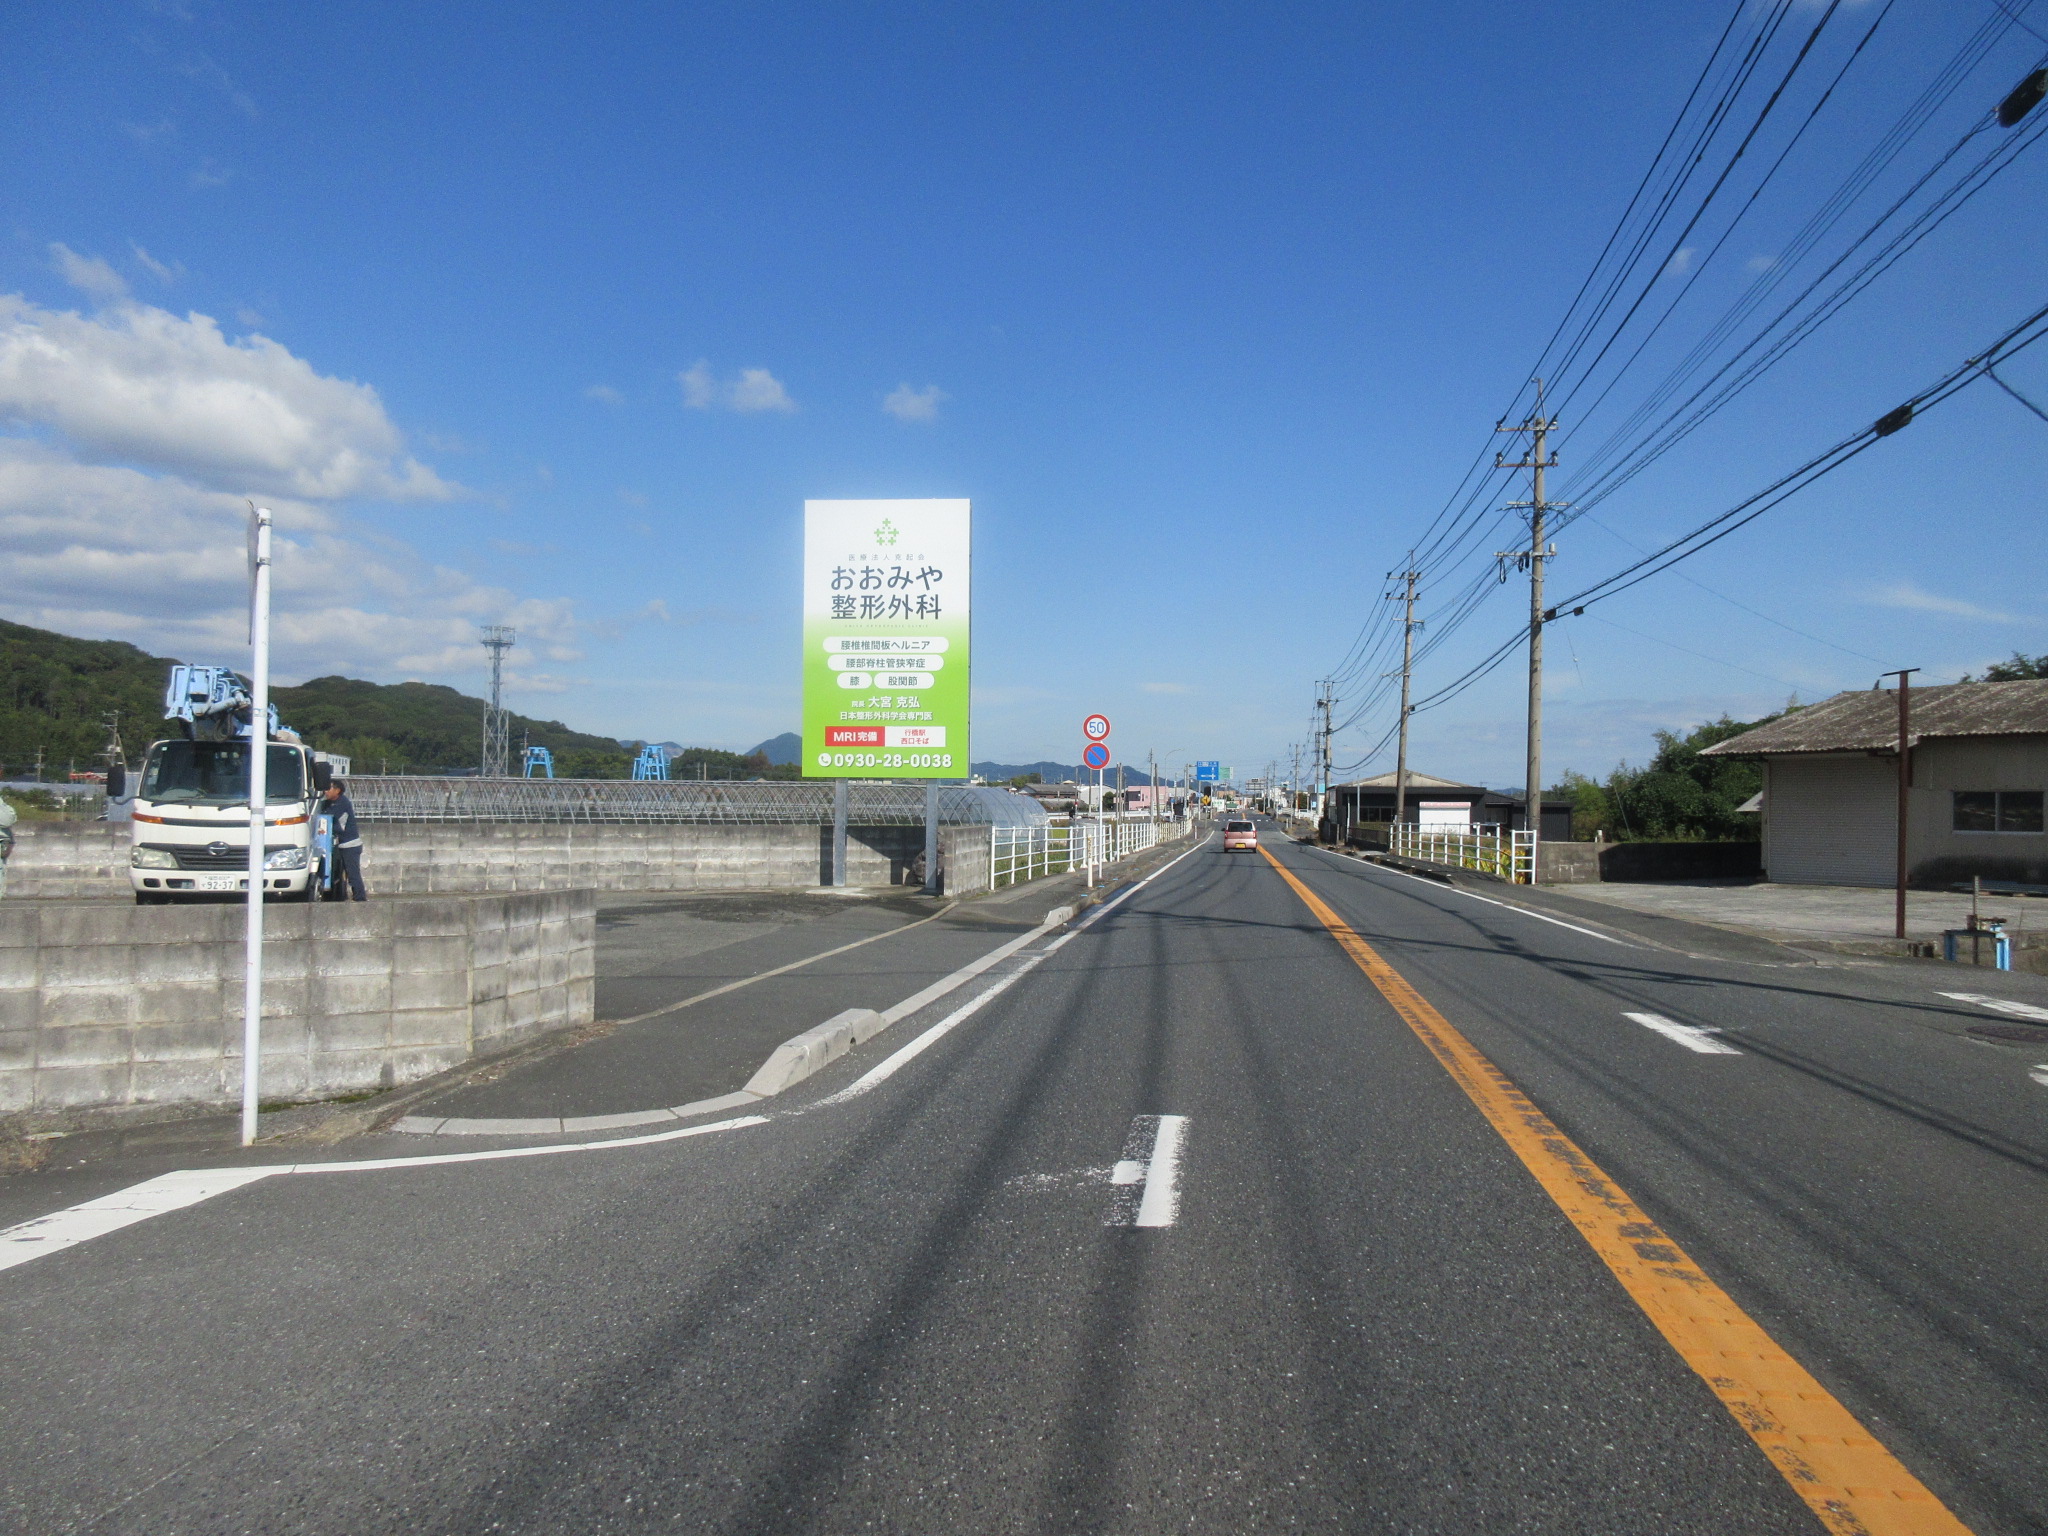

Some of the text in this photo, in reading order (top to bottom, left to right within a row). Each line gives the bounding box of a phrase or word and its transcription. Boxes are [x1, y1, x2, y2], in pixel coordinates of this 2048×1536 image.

[831, 566, 943, 590] おおみや
[831, 594, 941, 620] 整形外科
[841, 640, 930, 650] 腰椎椎間板ヘルニア
[846, 658, 926, 668] 腰部脊柱管狭窄症
[850, 676, 918, 686] 膝 股関節
[868, 696, 892, 708] 大宮
[896, 696, 920, 708] 克弘
[840, 712, 932, 721] 日本整形外科学会専門医
[1089, 722, 1104, 734] 50
[834, 754, 952, 768] 0930-28-0038
[206, 881, 234, 890] 92-37
